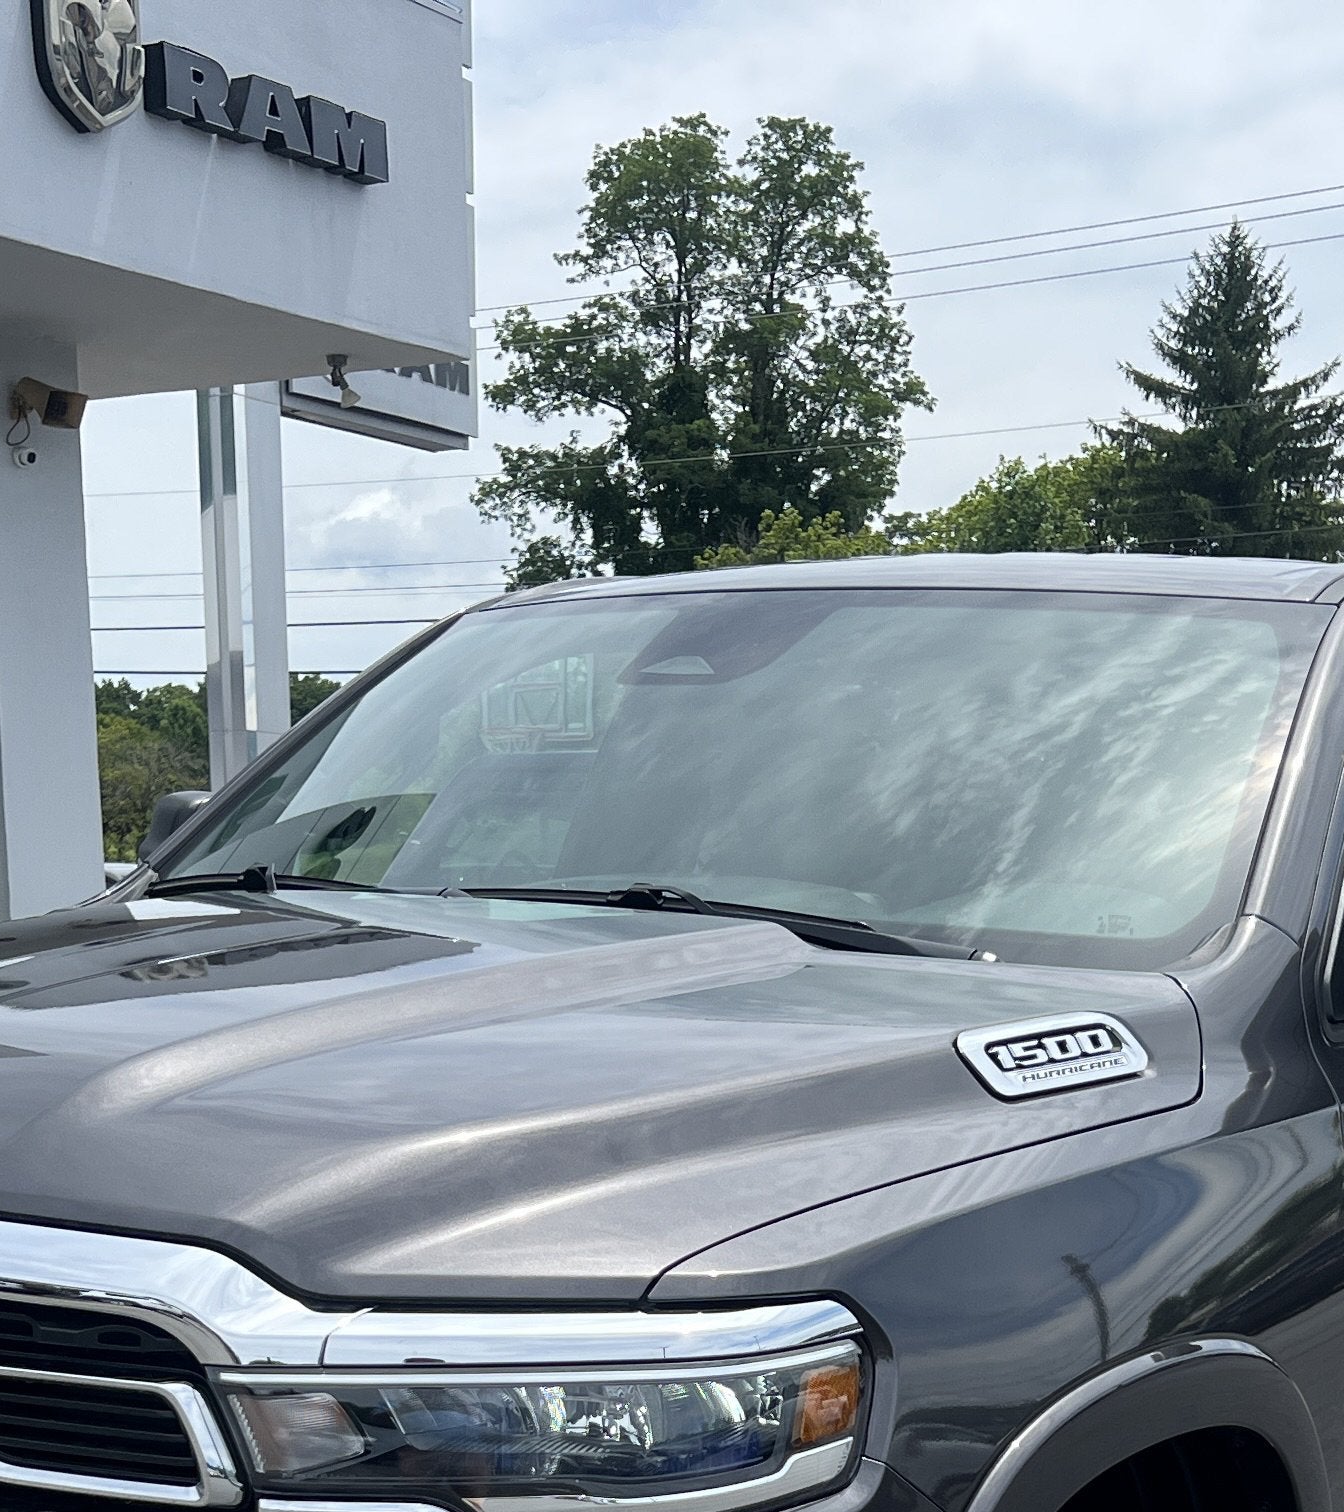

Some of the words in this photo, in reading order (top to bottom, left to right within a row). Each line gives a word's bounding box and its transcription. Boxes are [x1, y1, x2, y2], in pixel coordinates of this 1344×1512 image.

[143, 41, 389, 185] RAM
[380, 359, 470, 397] AM
[988, 1027, 1114, 1070] 1500
[1021, 1056, 1125, 1083] HURRICANE
